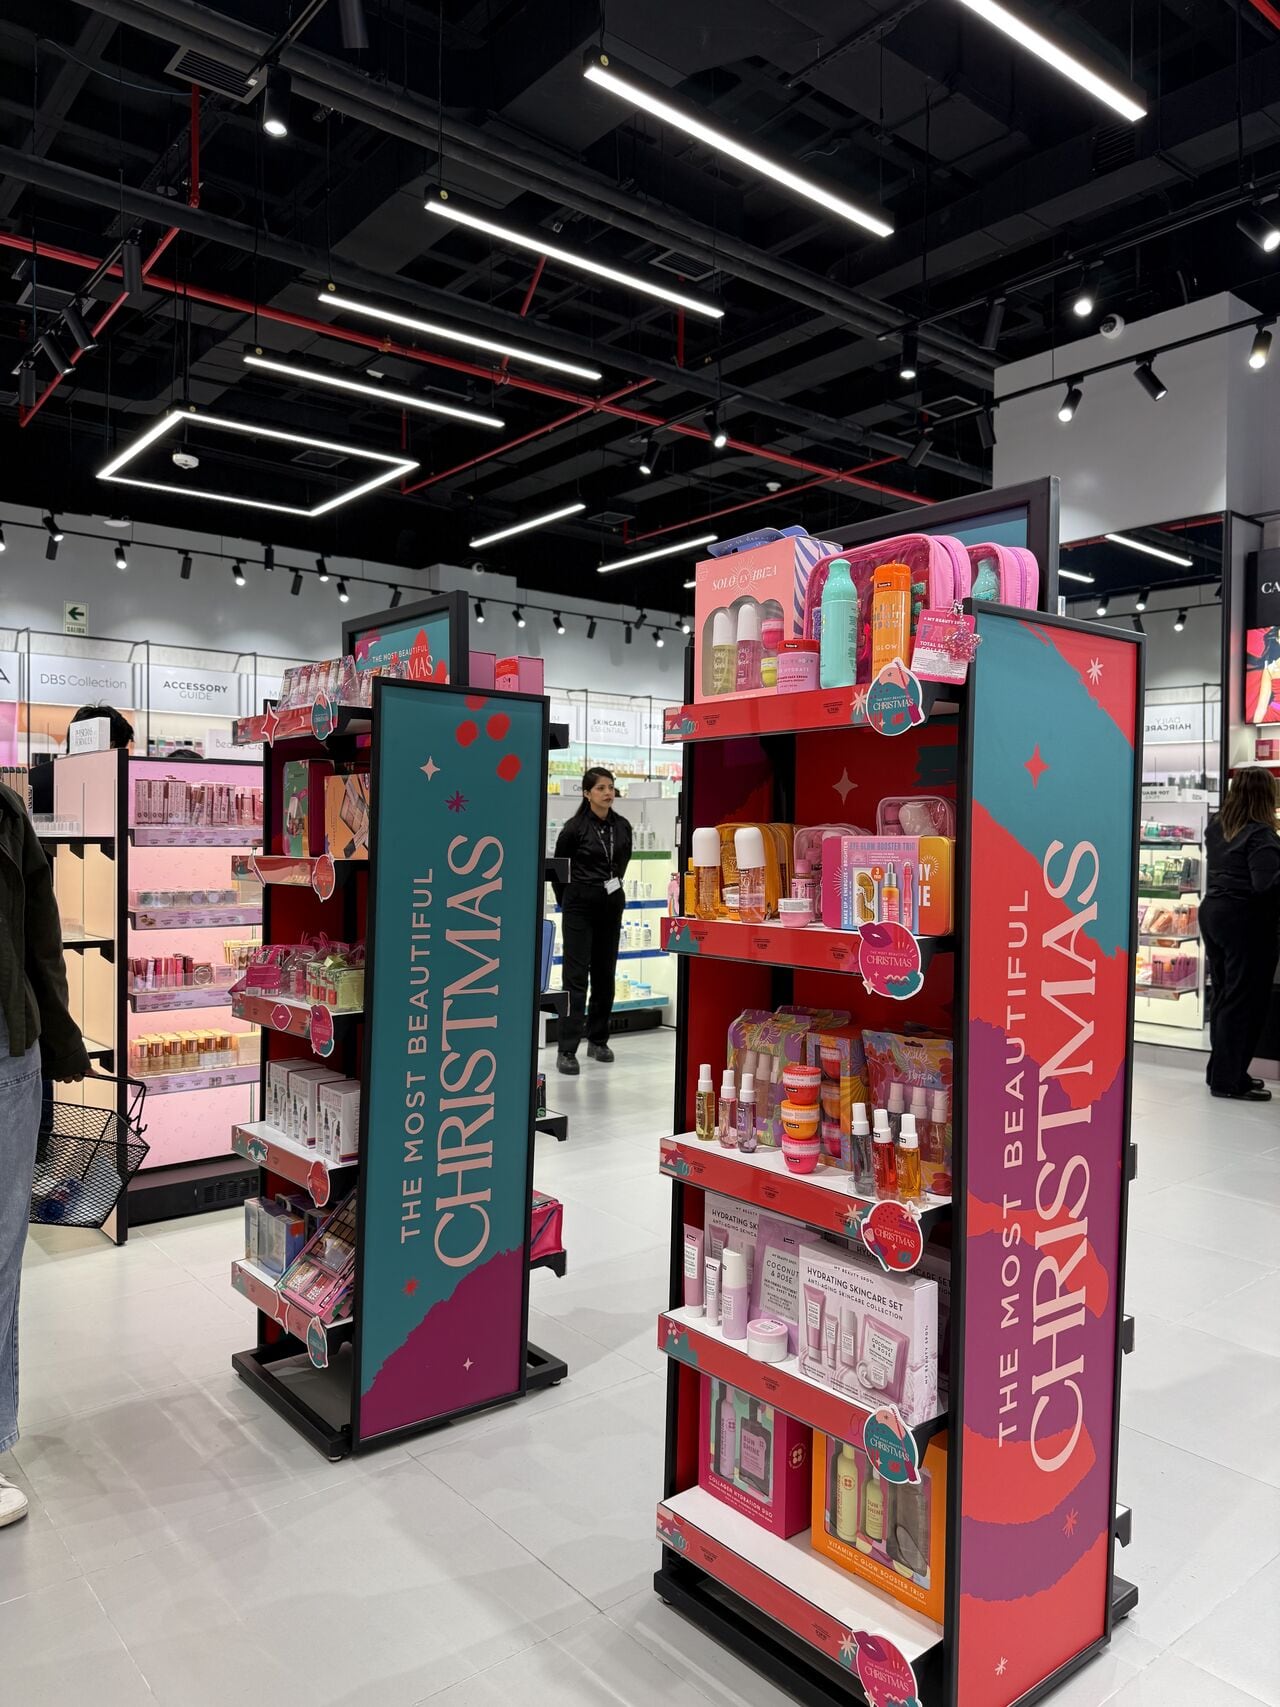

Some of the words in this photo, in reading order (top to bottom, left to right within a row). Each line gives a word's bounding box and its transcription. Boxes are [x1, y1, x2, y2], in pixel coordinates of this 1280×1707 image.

[712, 575, 735, 591] SOLO
[752, 565, 777, 581] IBIZA
[66, 626, 85, 634] SALIDA
[372, 654, 382, 663] THE
[398, 644, 428, 658] BEAUTIFUL
[163, 680, 228, 693] ACCESSORY
[180, 690, 213, 701] GUIDE
[873, 698, 914, 711] CHRISTMAS
[592, 719, 626, 728] SKINCARE
[408, 867, 433, 1054] BEAUTIFUL
[866, 955, 912, 968] CHRISTMAS
[1003, 890, 1029, 1169] BEAUTIFUL
[434, 834, 505, 1268] CHRISTMAS
[404, 1071, 426, 1163] MOST
[1030, 839, 1100, 1472] CHRISTMAS
[401, 1176, 422, 1244] THE
[712, 1209, 748, 1227] HYDRATING
[874, 1227, 915, 1249] CHRISTMAS
[766, 1260, 799, 1278] COCONUT
[1001, 1193, 1022, 1329] MOST
[807, 1266, 849, 1290] HYDRATING
[849, 1283, 887, 1306] SKINCARE
[888, 1298, 904, 1312] SET
[807, 1277, 838, 1294] ANTI-AGING
[838, 1289, 865, 1306] SKINCARE
[866, 1302, 904, 1321] COLLECTION
[872, 1337, 894, 1353] COCONUT
[999, 1348, 1019, 1448] THE
[743, 1435, 755, 1446] SUN
[743, 1442, 760, 1457] SHINE
[870, 1437, 910, 1462] CHRISTMAS
[708, 1474, 733, 1494] COLLAGEN
[828, 1539, 854, 1559] VITAMIN
[880, 1569, 909, 1590] BOOSTER
[910, 1585, 925, 1600] TRIO
[864, 1665, 910, 1693] CHRISTMAS
